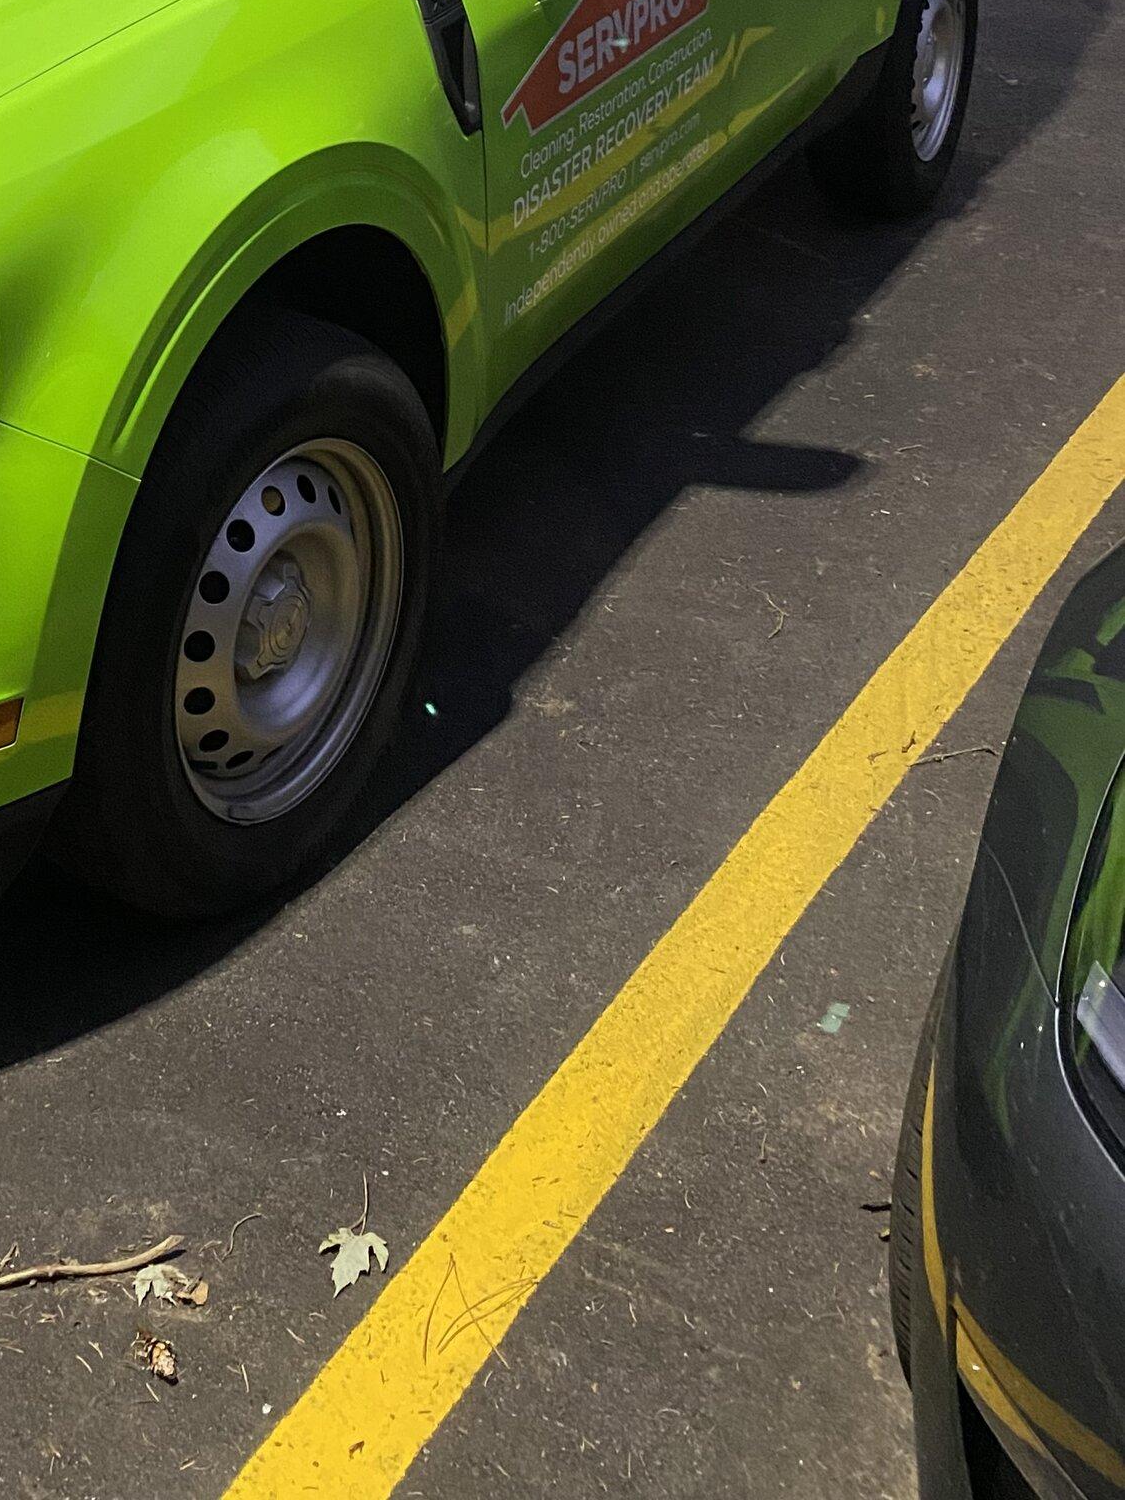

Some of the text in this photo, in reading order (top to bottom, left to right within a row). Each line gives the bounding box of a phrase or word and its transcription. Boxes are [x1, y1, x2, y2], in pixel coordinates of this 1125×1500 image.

[514, 49, 716, 229] DISASTER RECOVERY TEAM
[528, 166, 627, 262] 1-800-SERVPRO
[504, 235, 595, 326] Independently
